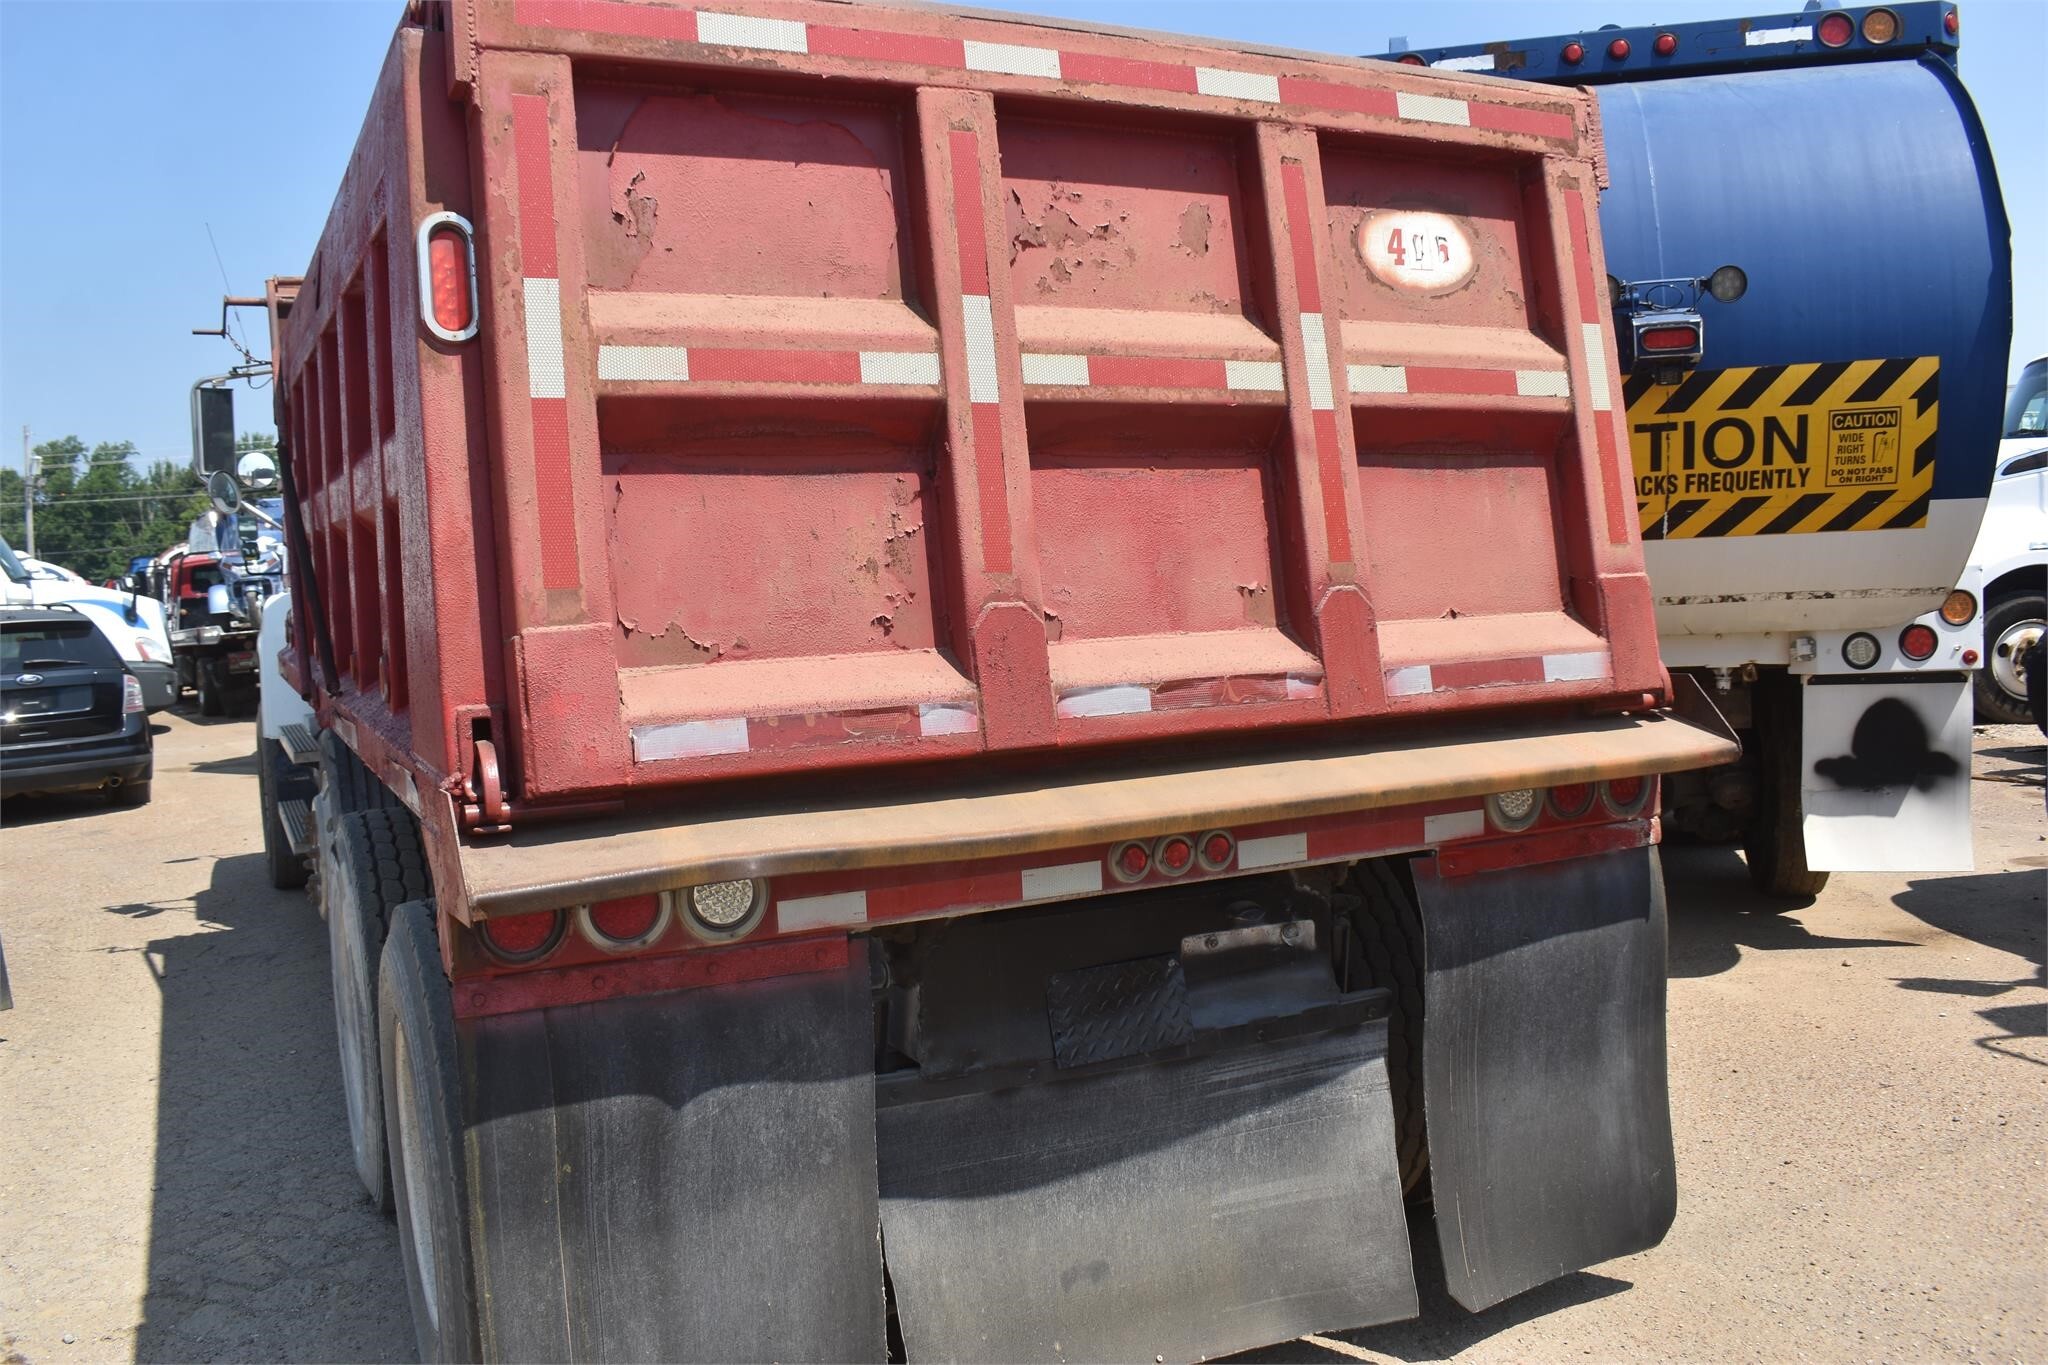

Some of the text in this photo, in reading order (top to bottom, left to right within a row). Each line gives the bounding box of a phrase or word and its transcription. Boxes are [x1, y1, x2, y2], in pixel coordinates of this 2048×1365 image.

[1834, 413, 1896, 428] CAUTION
[1634, 414, 1808, 472] TION
[1839, 433, 1864, 443] WIDE
[1837, 444, 1865, 454] RIGHT
[1834, 455, 1866, 465] TURNS
[1869, 466, 1893, 474] PASS
[1685, 467, 1811, 494] FREQUENTLY
